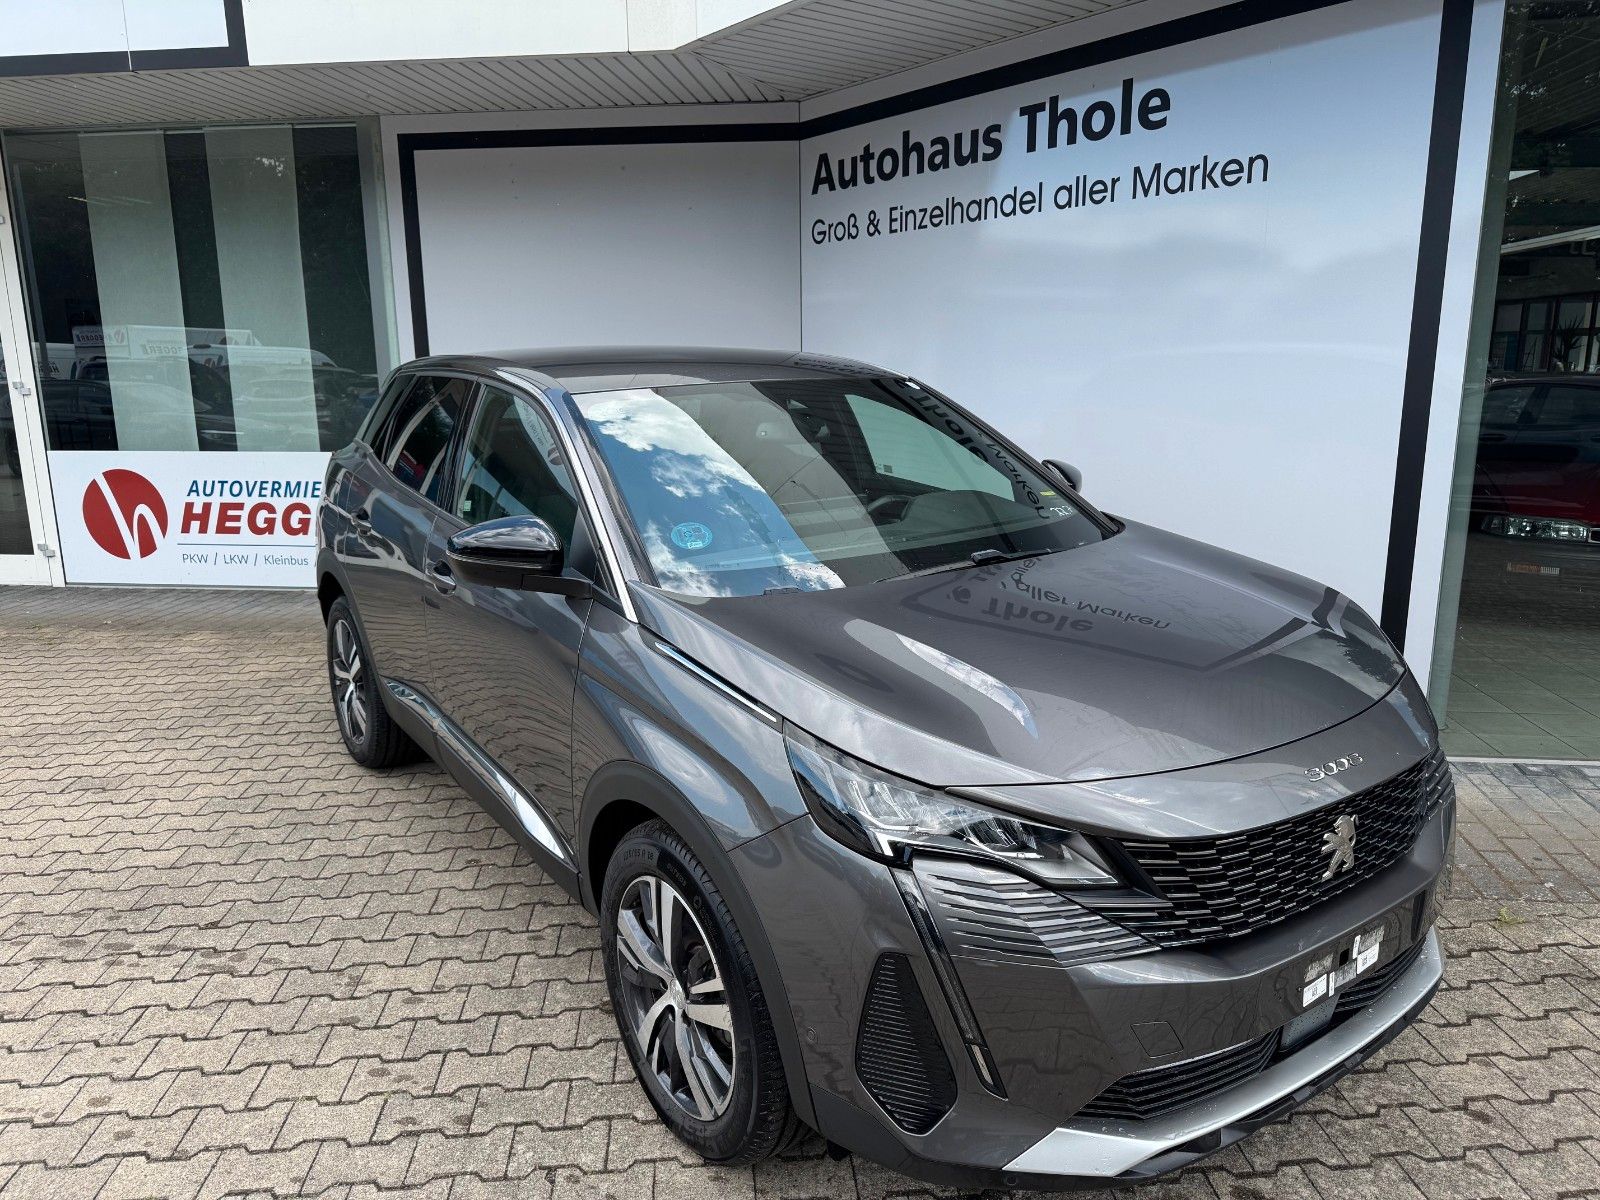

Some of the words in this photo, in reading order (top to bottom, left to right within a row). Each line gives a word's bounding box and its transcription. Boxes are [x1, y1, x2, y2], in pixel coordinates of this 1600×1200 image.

[811, 123, 1002, 196] Autohaus
[1019, 77, 1172, 153] Thole
[811, 218, 860, 245] Groß
[865, 213, 882, 236] &
[888, 181, 1044, 236] Einzelhandel
[1053, 173, 1121, 210] aller
[1131, 152, 1270, 200] Marken
[187, 480, 321, 498] AUTOVERMIE
[181, 502, 312, 536] HEGG
[182, 553, 208, 564] PKW
[223, 554, 249, 565] LKW
[264, 554, 309, 566] Kleinbus
